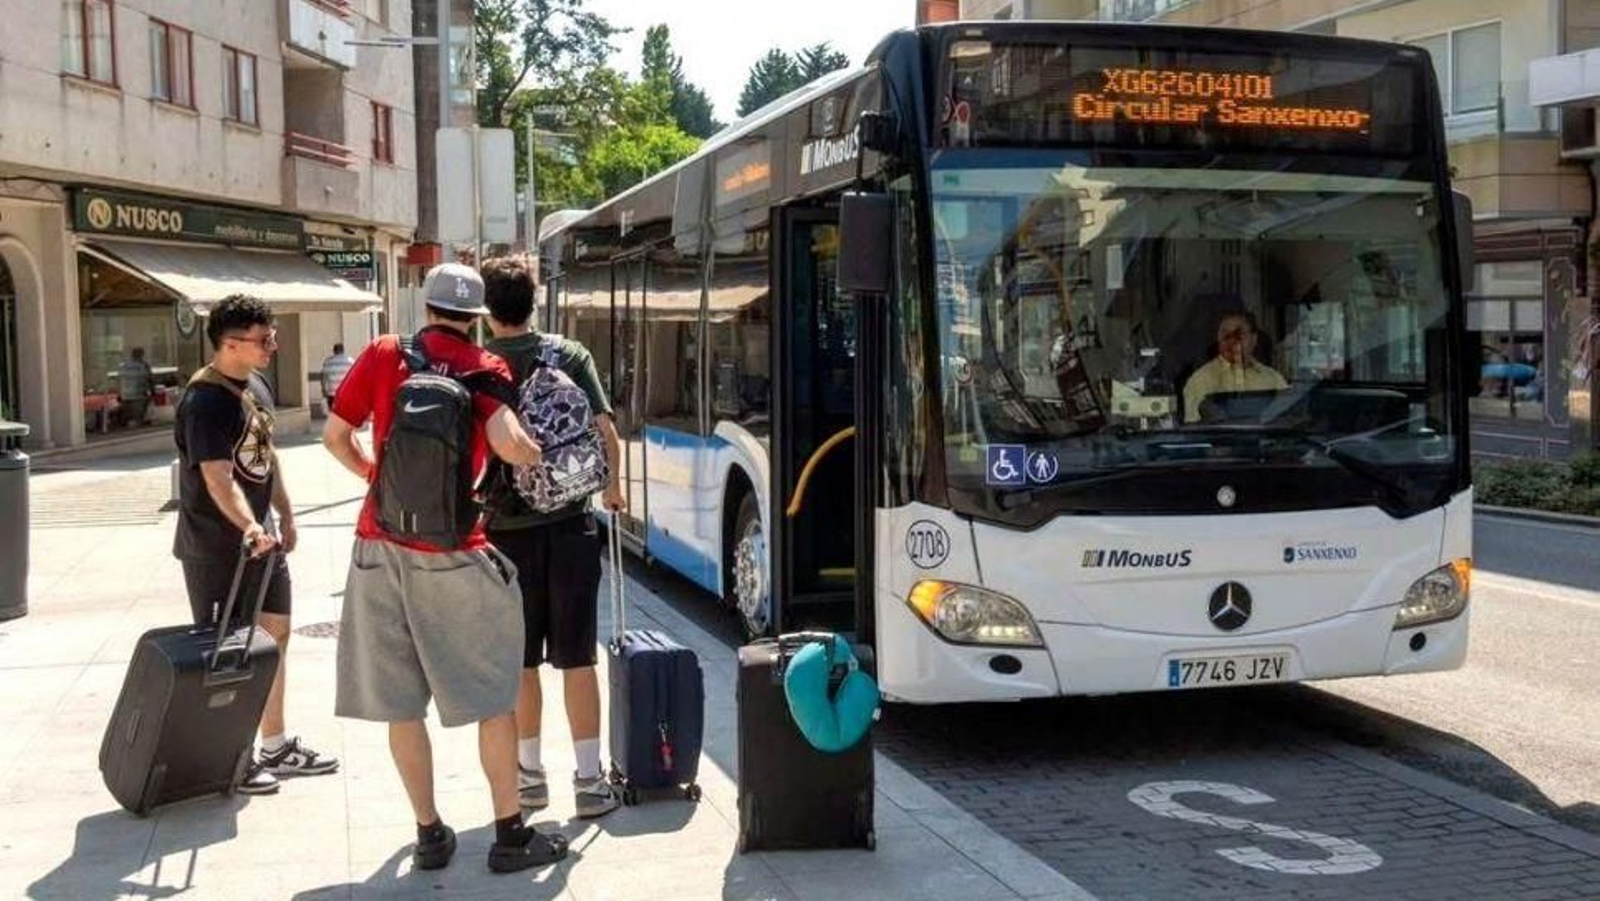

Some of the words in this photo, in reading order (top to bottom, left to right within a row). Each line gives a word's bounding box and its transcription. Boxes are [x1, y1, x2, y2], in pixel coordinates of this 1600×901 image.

[1102, 68, 1273, 99] XG62604101
[1074, 93, 1208, 122] Circular
[116, 204, 183, 233] NUSCO
[328, 253, 371, 264] NUSCO
[910, 530, 945, 559] 2708
[1107, 549, 1193, 568] MONBUS
[1297, 547, 1358, 560] SANXENXO
[1182, 660, 1236, 684] 7746
[1246, 657, 1284, 680] JZV
[1127, 780, 1384, 874] S
